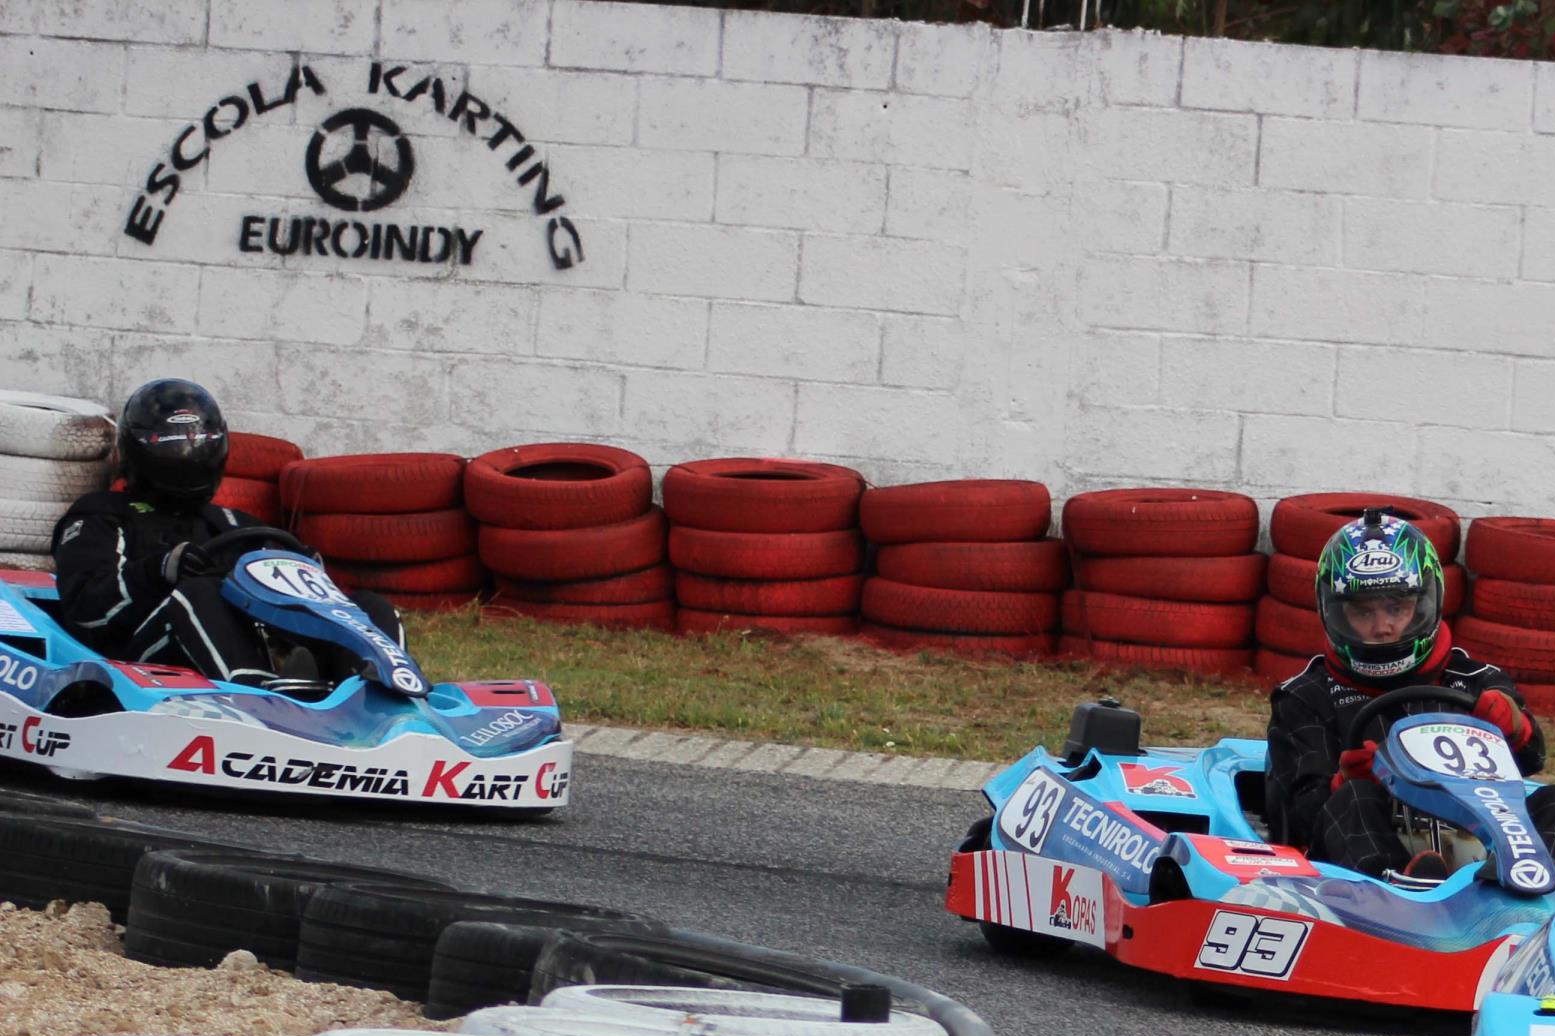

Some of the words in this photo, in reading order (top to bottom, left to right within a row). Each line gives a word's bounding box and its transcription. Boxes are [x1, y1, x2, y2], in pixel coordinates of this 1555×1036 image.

[124, 64, 326, 246] ESCOLA
[368, 62, 586, 271] KARTING
[239, 215, 484, 266] EUROINDY
[1352, 554, 1394, 569] Arai
[1352, 660, 1405, 671] CHRISTIAN
[22, 716, 71, 757] CUP
[1419, 726, 1502, 744] EUROINDY
[1433, 735, 1497, 774] 93
[166, 735, 409, 796] ACADEMIA
[421, 760, 529, 800] KART
[1015, 780, 1059, 848] 93
[1063, 797, 1160, 874] TECNIROLO
[1051, 865, 1097, 936] KOPAS
[1198, 910, 1308, 977] 93
